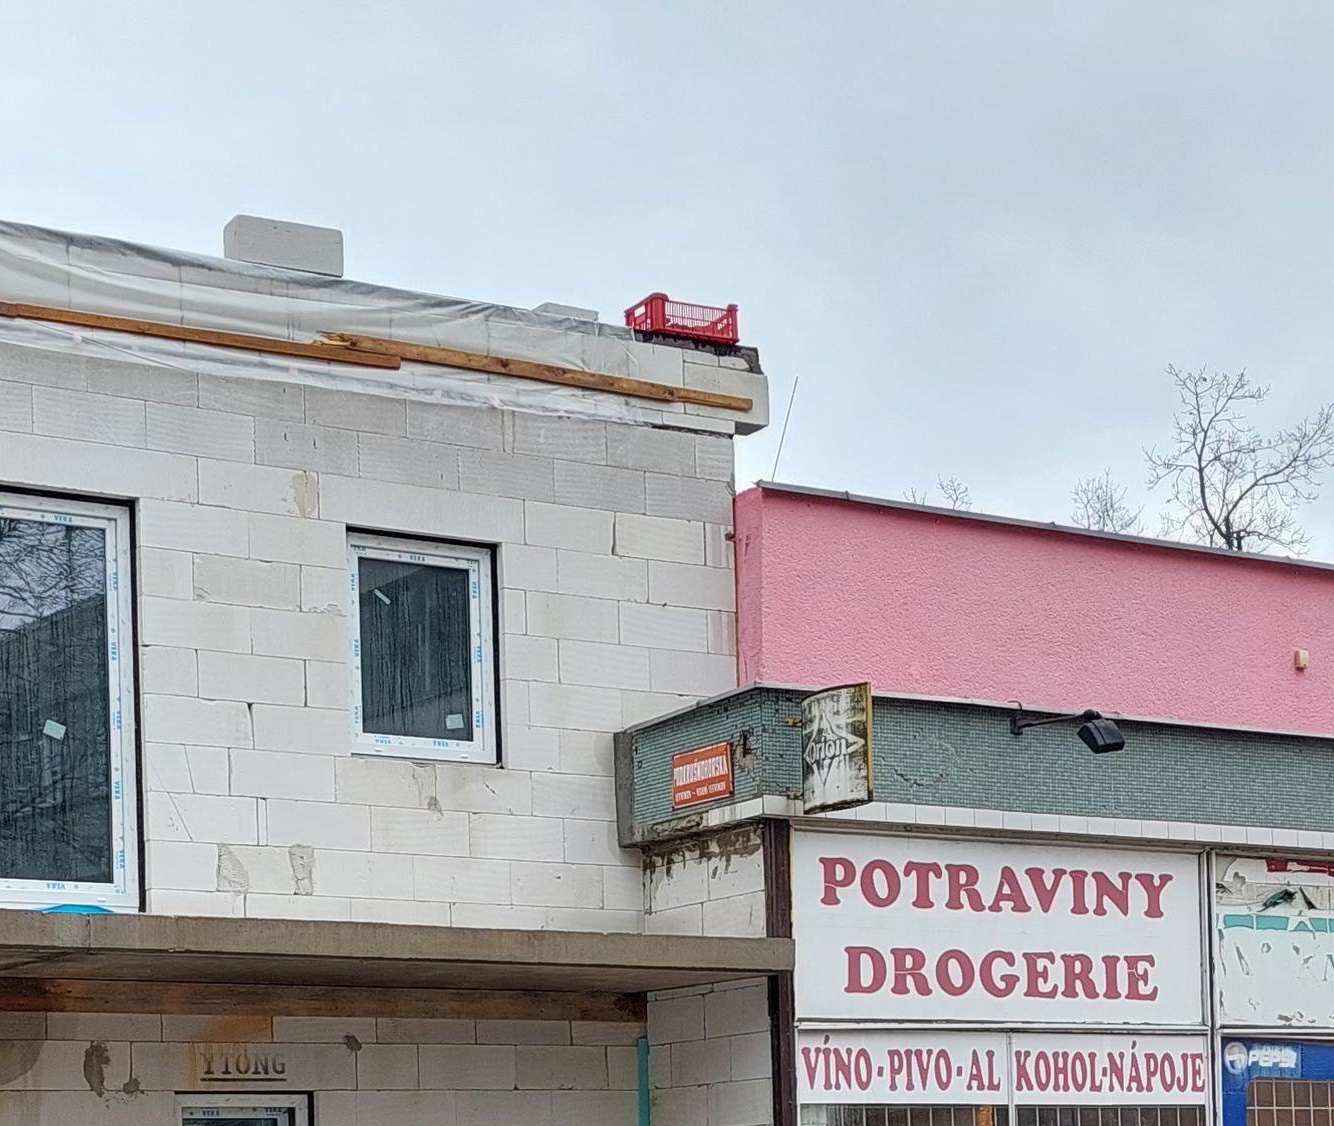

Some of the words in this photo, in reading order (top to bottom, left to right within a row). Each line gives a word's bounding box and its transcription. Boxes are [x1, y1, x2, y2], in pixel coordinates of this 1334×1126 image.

[818, 857, 1174, 918] POTRAVINY
[843, 945, 1160, 1002] DROGERIE
[201, 1051, 286, 1076] YTONG
[1248, 1047, 1297, 1068] PEPSI
